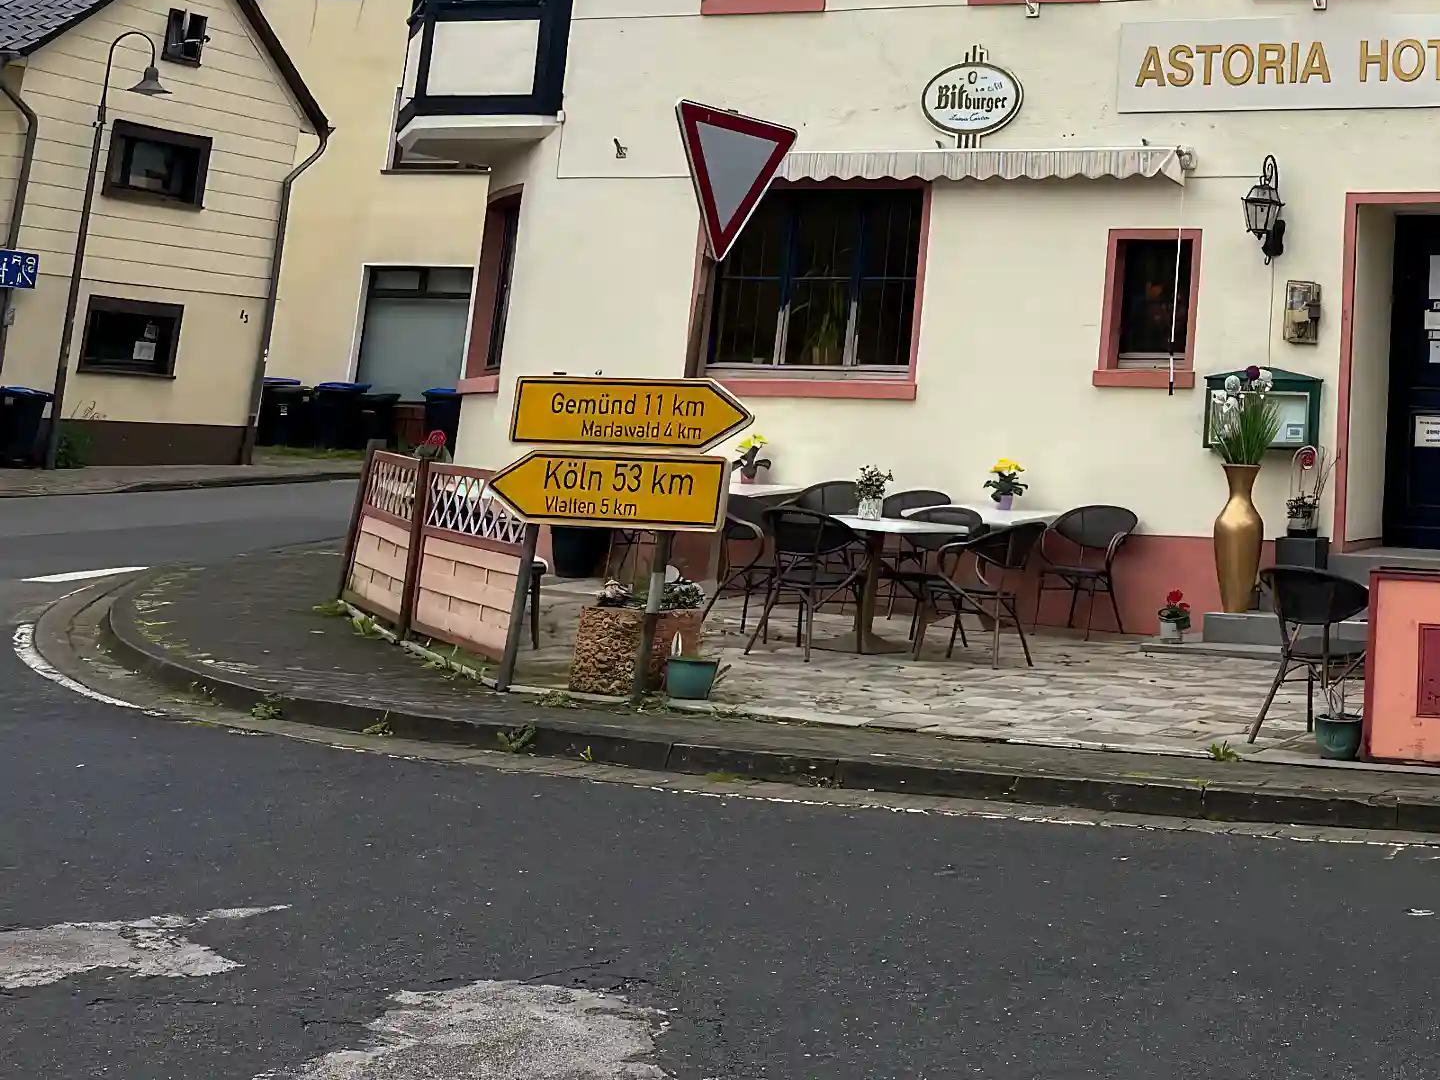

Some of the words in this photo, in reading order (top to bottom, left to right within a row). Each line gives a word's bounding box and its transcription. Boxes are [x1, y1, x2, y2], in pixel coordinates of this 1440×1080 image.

[1135, 39, 1332, 88] ASTORIA
[551, 392, 637, 415] Gemünd
[646, 393, 664, 415] 11
[672, 394, 705, 417] km
[664, 421, 673, 437] 4
[678, 422, 702, 440] km
[543, 460, 603, 491] Köln
[612, 463, 643, 493] 53
[651, 465, 694, 496] km
[600, 498, 610, 515] 5
[613, 499, 637, 517] km
